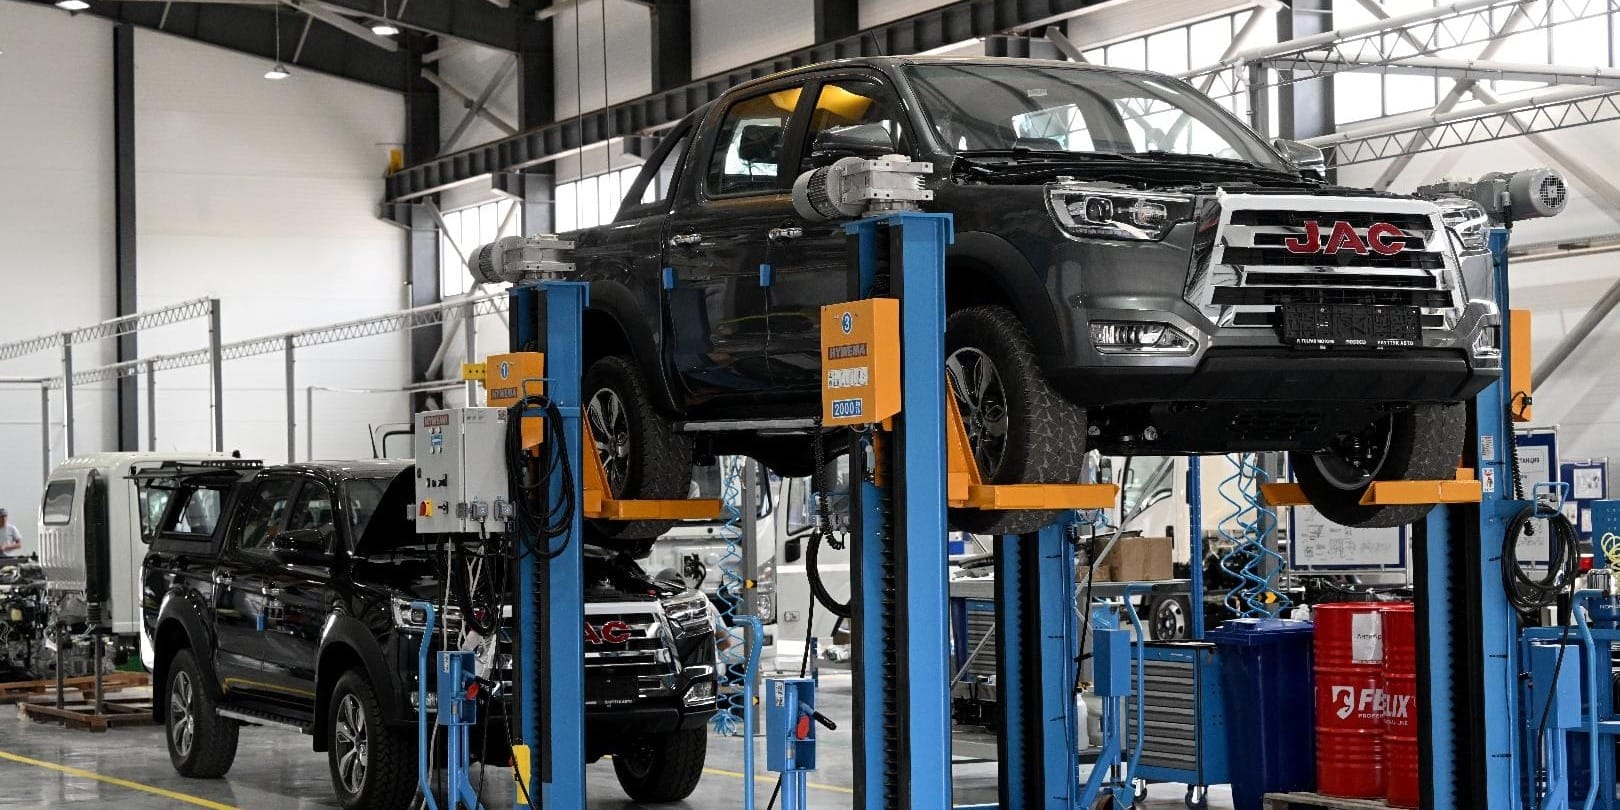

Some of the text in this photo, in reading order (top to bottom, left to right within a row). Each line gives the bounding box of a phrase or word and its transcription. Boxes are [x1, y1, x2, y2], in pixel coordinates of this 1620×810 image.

[1285, 220, 1406, 255] JAC
[844, 315, 850, 331] 3
[834, 401, 854, 416] 2000
[585, 621, 631, 644] AC
